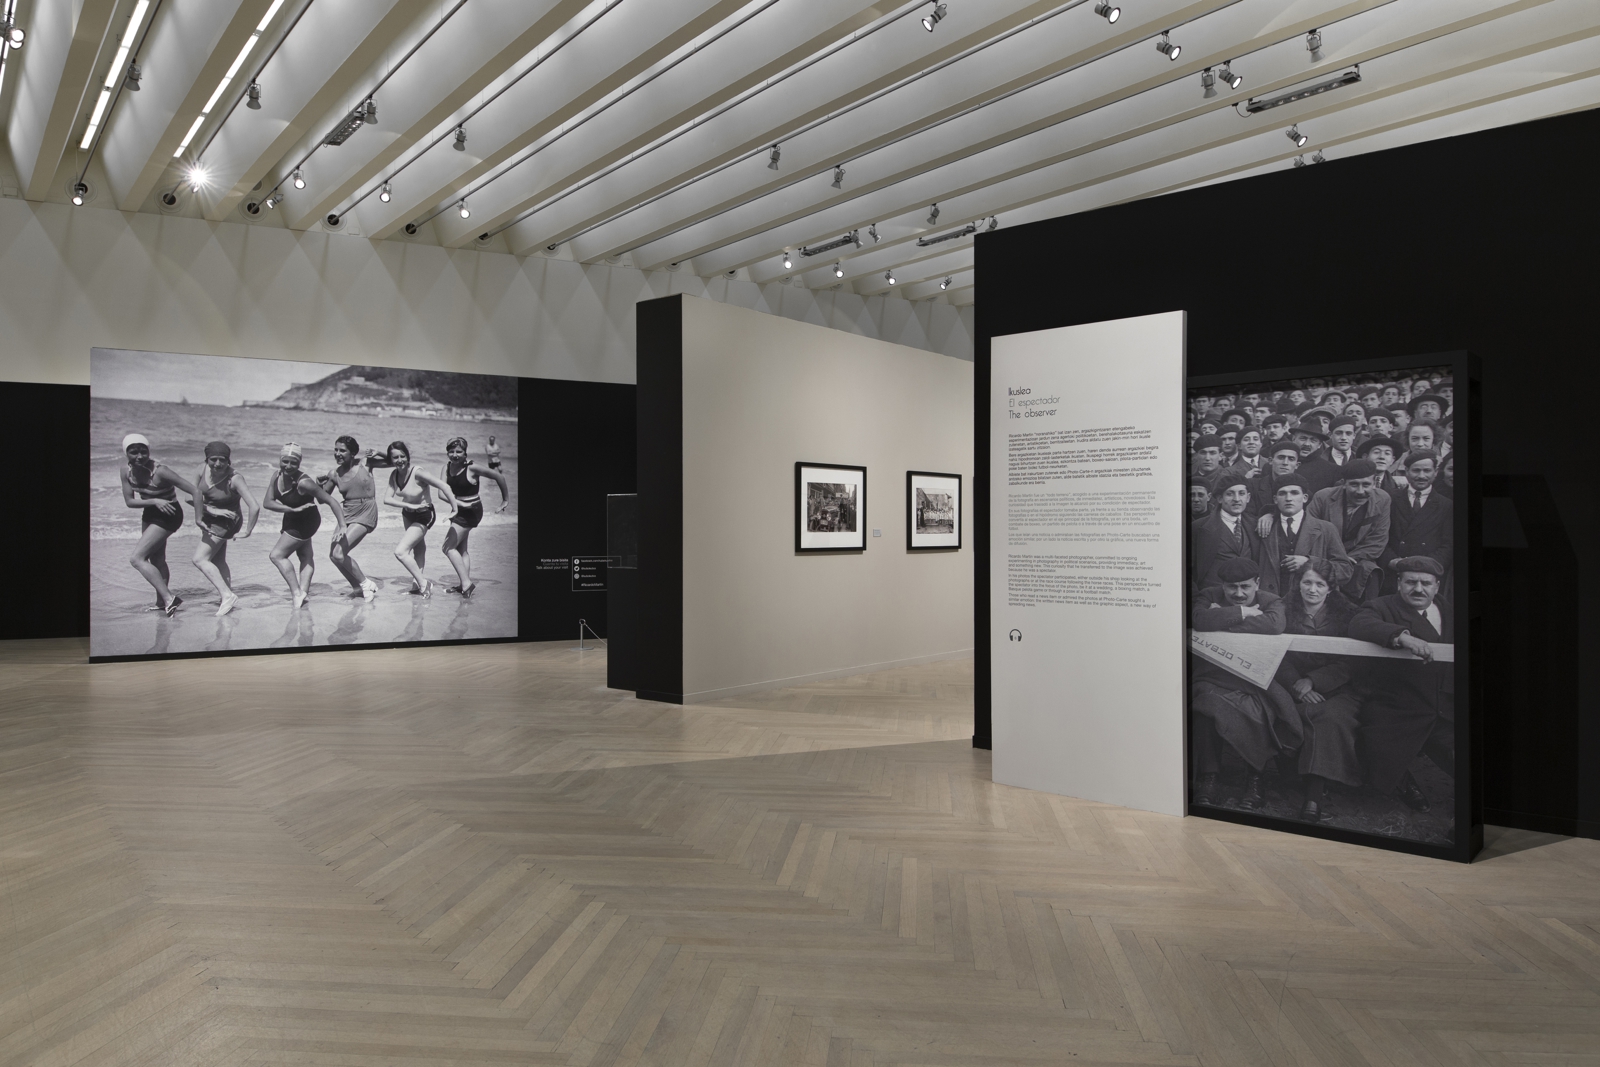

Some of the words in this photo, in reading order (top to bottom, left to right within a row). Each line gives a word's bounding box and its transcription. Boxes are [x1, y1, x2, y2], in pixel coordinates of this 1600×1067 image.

[1018, 395, 1060, 409] espectador
[1009, 410, 1021, 419] The
[1025, 408, 1057, 418] observer
[1192, 636, 1234, 660] DEBATE
[1236, 656, 1252, 670] EL
